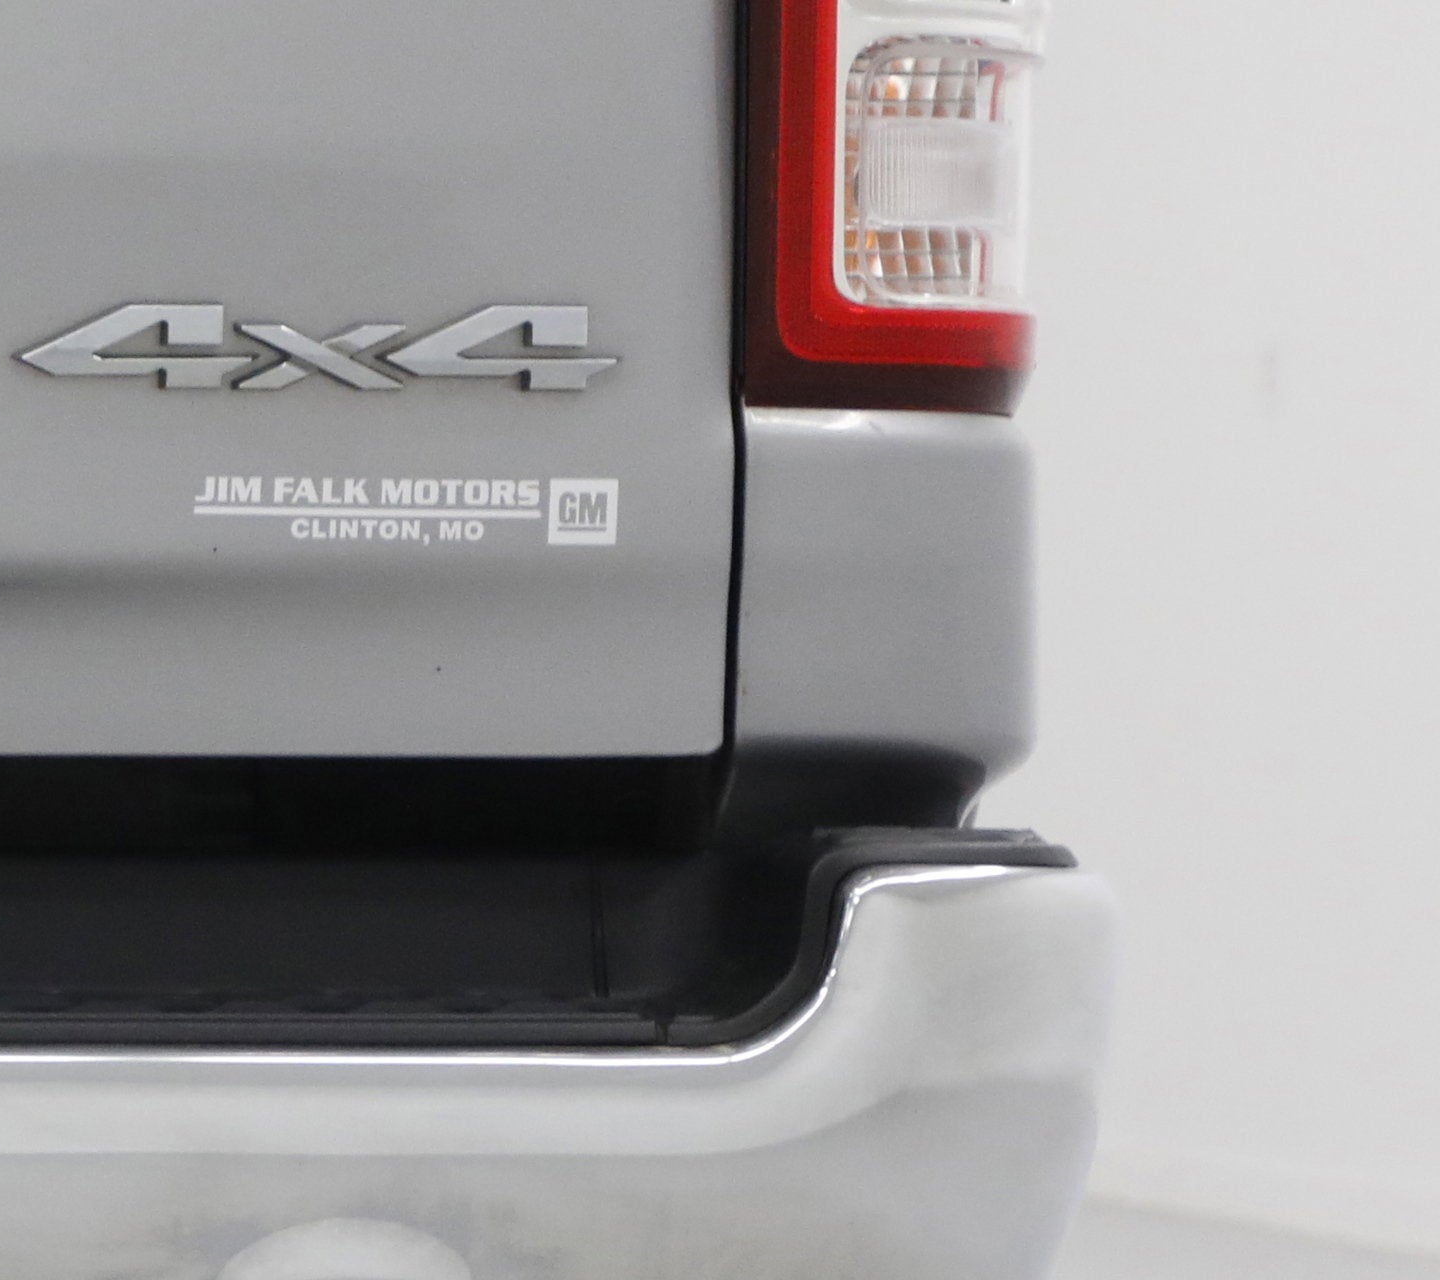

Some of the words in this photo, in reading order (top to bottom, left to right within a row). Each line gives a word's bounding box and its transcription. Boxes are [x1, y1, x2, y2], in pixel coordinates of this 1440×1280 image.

[194, 476, 262, 503] JIM
[273, 477, 369, 504] FALK
[381, 478, 540, 506] MOTORS
[557, 490, 608, 526] GM
[290, 518, 431, 546] CLINTON,
[439, 520, 484, 540] MO
